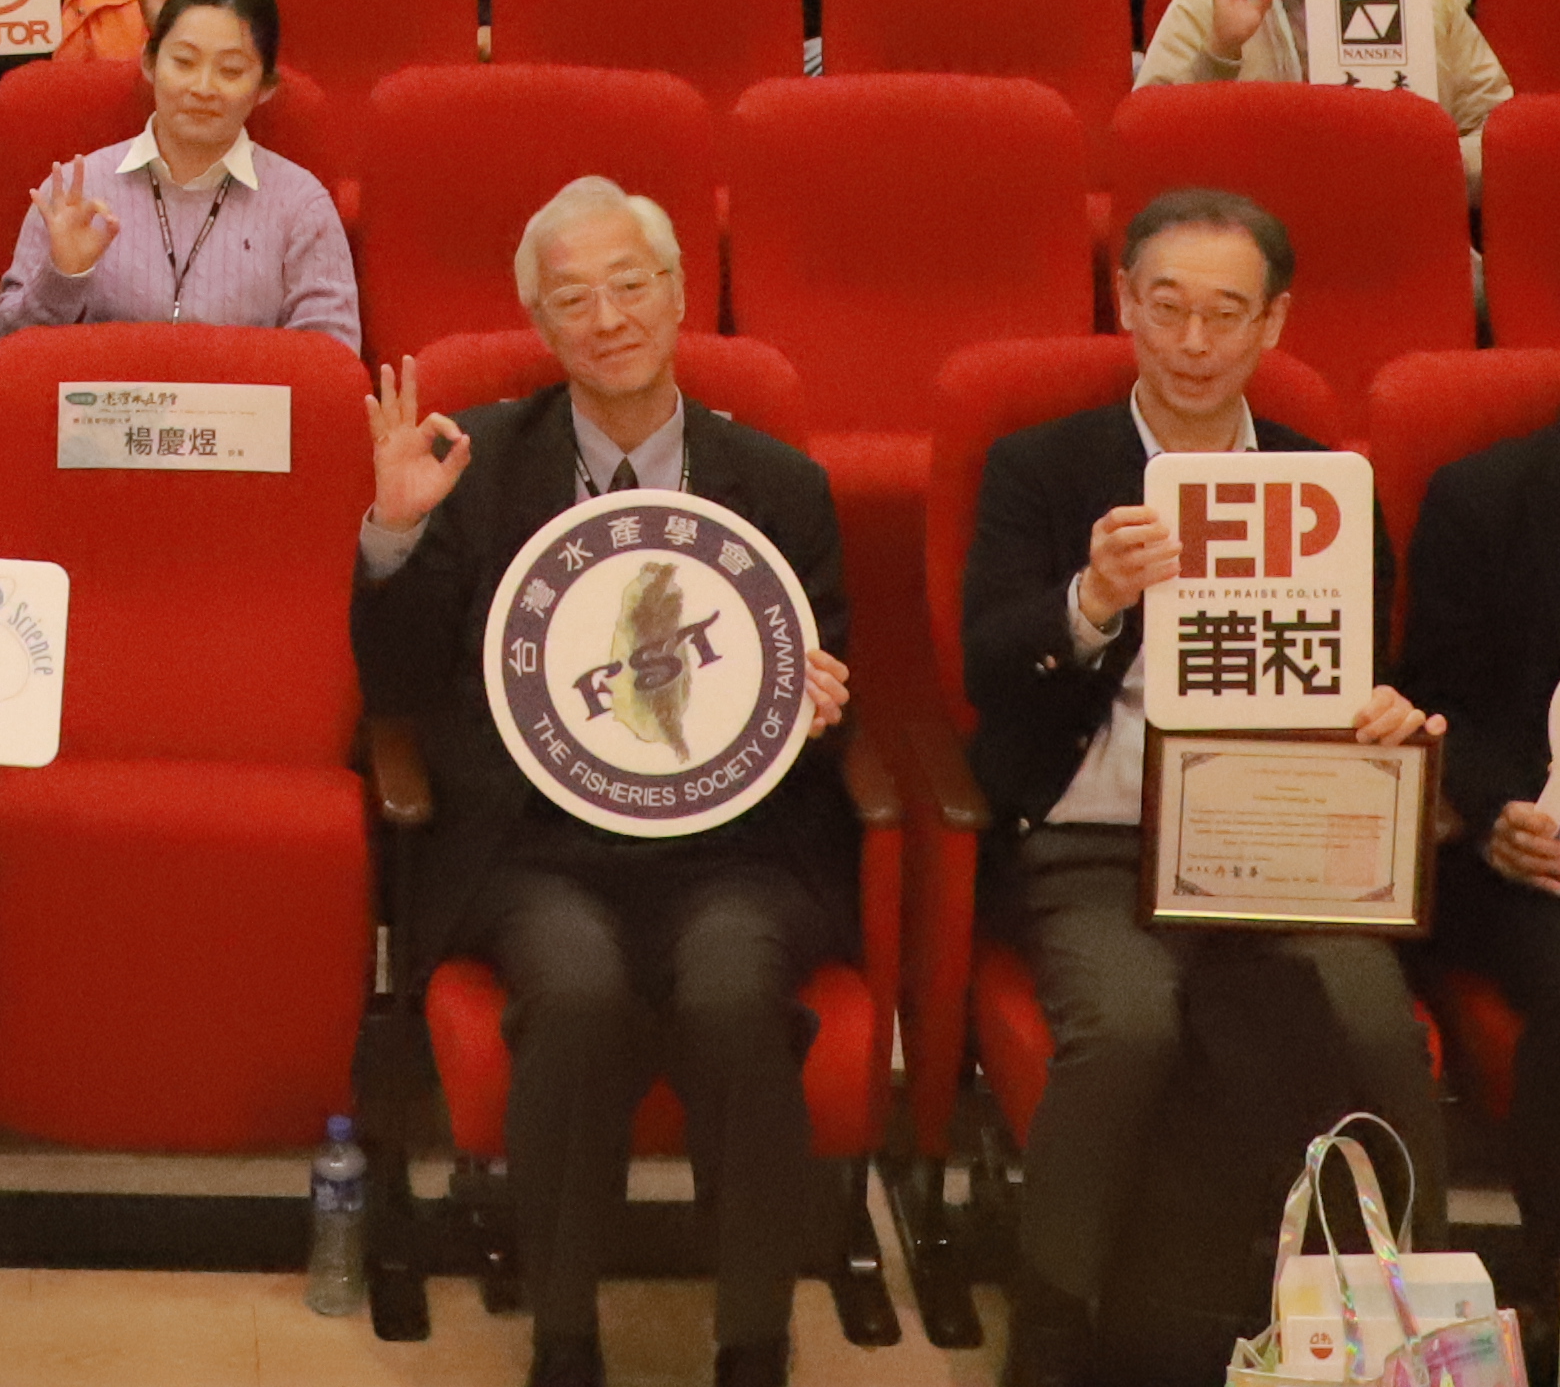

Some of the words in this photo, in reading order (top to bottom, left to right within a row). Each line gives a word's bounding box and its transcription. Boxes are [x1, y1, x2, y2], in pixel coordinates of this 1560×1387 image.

[1342, 47, 1403, 61] NANSEN
[124, 426, 218, 457] 楊慶煜
[508, 514, 755, 677] 台灣水產學會
[1178, 589, 1217, 599] EVER
[1224, 589, 1278, 599] PRAISE
[7, 602, 54, 678] Science
[763, 603, 795, 701] TAIWAN
[533, 712, 572, 766] THE
[760, 706, 785, 740] OF
[569, 760, 677, 807] FISHERIES
[683, 738, 765, 802] SOCIETY
